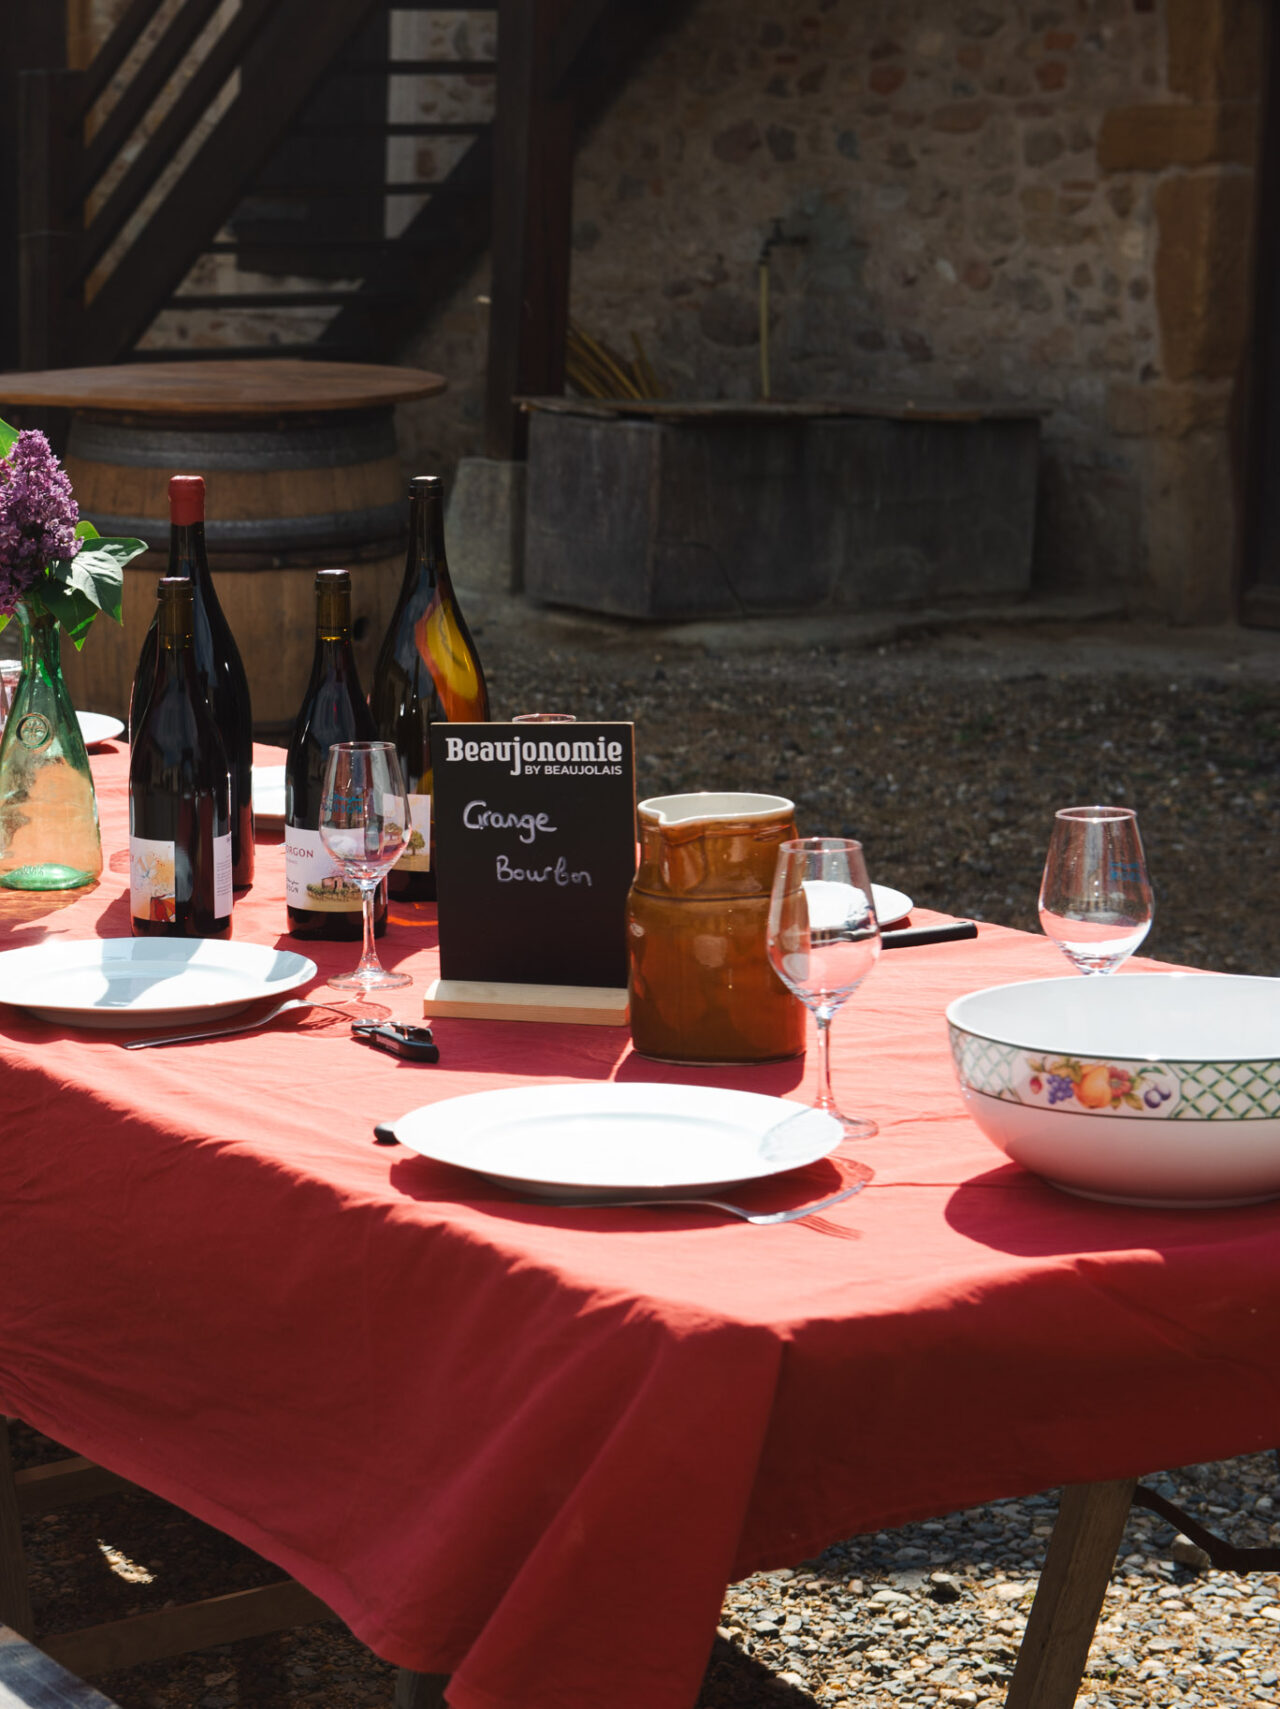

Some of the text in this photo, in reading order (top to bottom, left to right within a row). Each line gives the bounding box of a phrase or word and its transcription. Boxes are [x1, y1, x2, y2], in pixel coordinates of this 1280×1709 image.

[445, 736, 623, 776] Beaujonomie
[524, 765, 623, 776] BY BEAUJOLAIS
[463, 800, 557, 844] Grange
